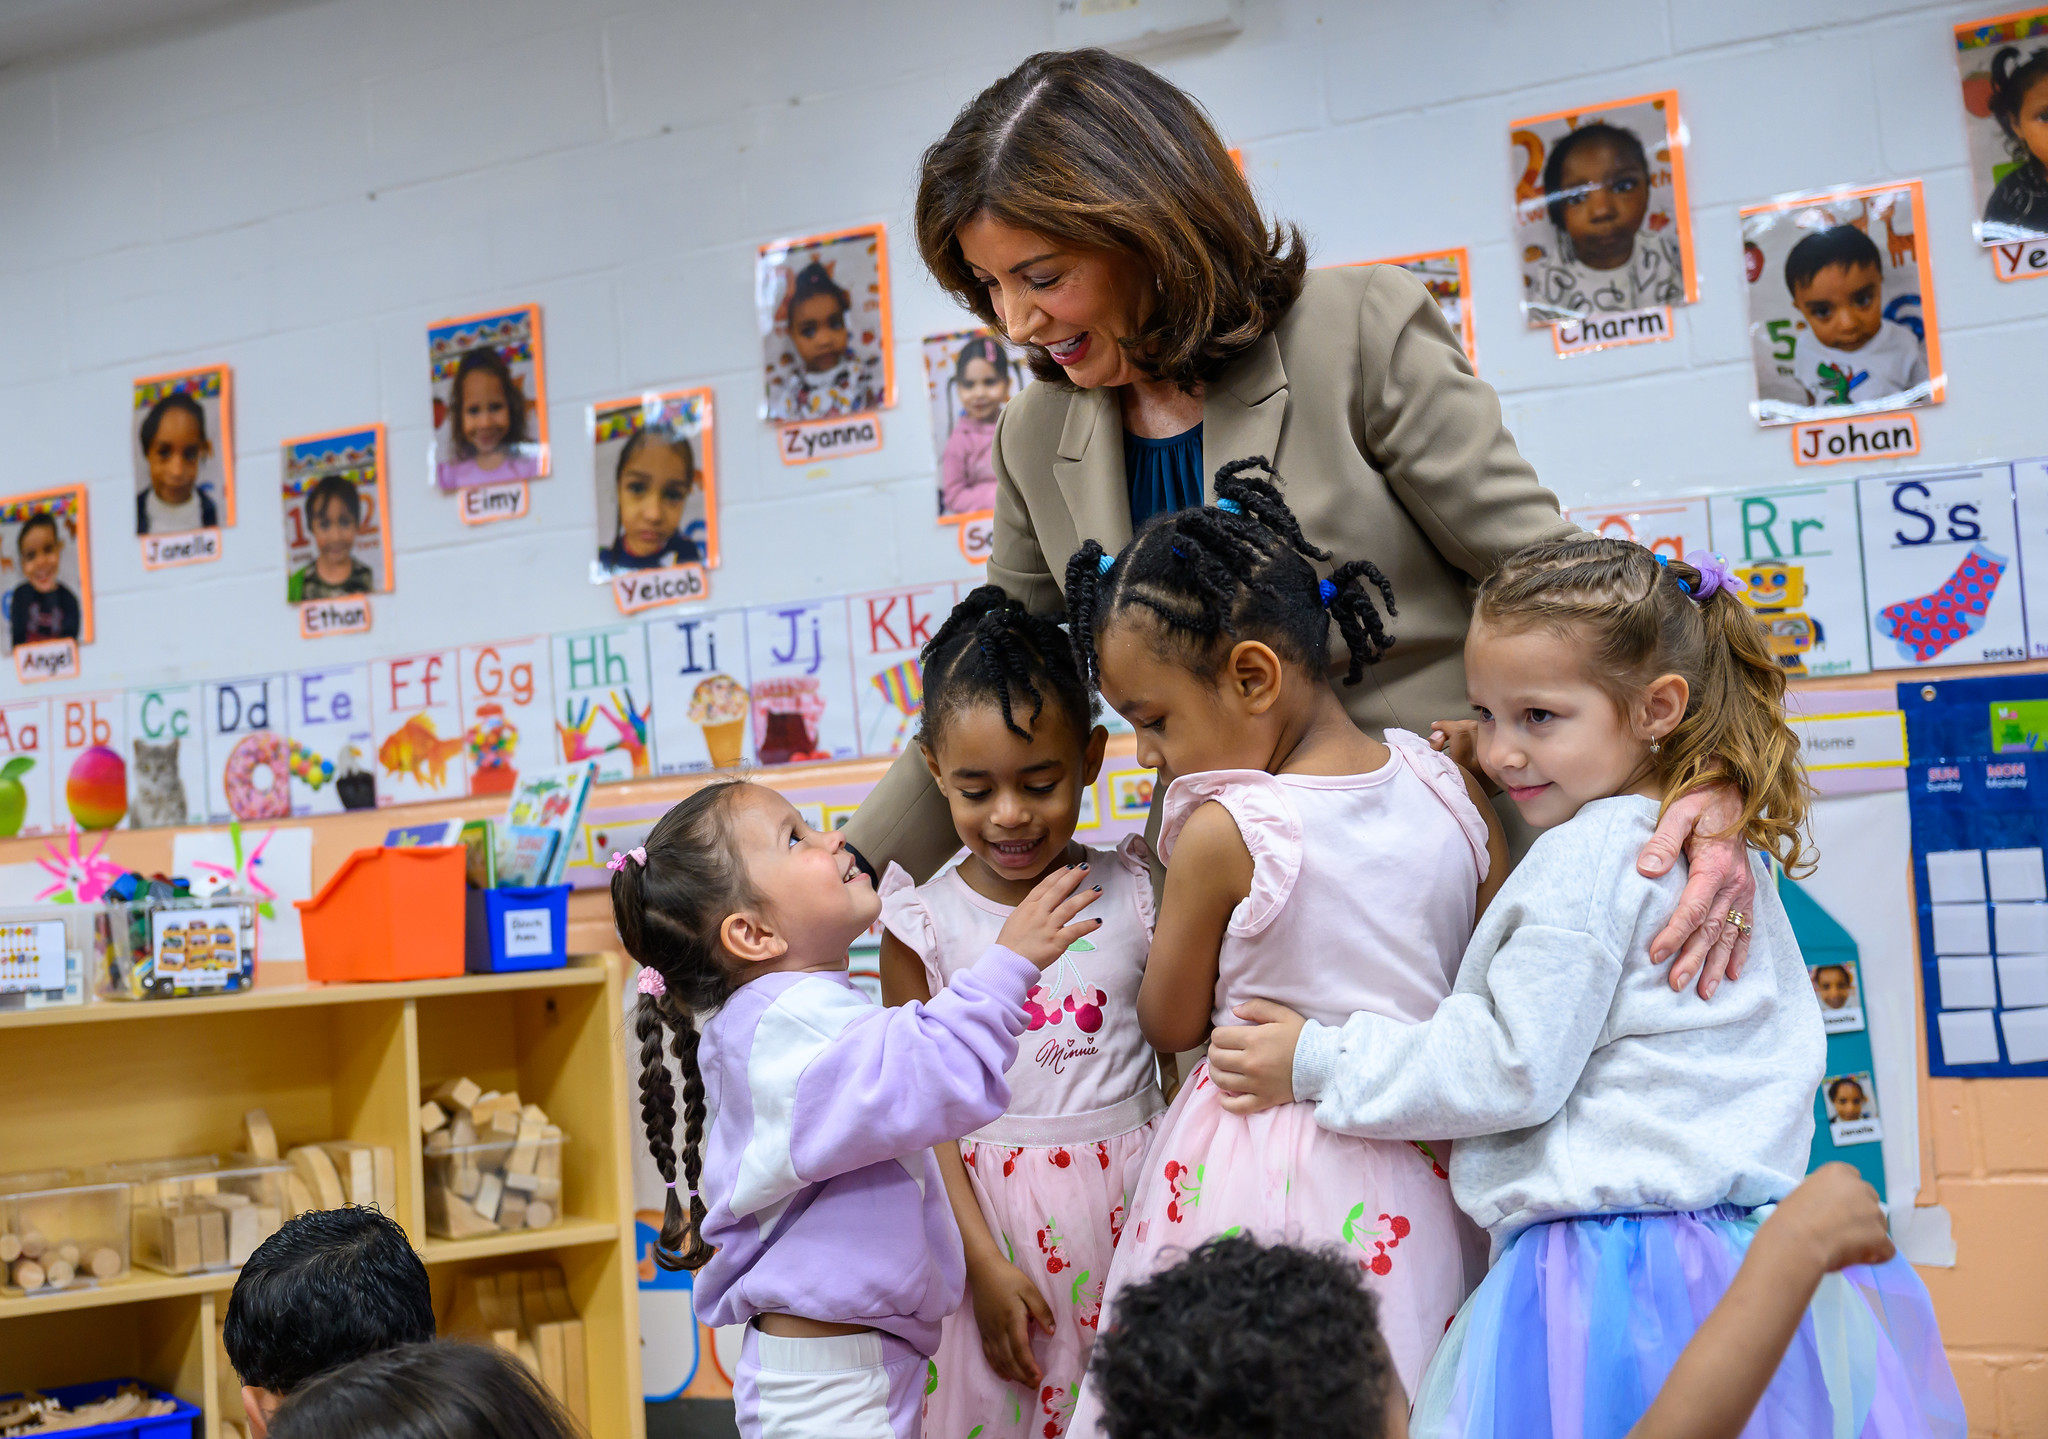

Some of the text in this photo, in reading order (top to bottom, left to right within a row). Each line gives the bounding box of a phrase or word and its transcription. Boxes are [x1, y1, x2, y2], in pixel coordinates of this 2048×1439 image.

[1560, 311, 1664, 345] Charm
[1766, 320, 1797, 361] 5
[784, 422, 875, 458] Zyanna
[1802, 423, 1912, 459] Johan
[465, 488, 522, 516] Eimy
[1891, 480, 1982, 546] Ss
[1741, 498, 1825, 560] Rr
[146, 539, 217, 562] Janelle
[619, 570, 702, 604] Yeicob
[305, 600, 367, 631] Ethan
[867, 594, 932, 654] Kk
[677, 621, 716, 675] Ii
[771, 608, 822, 675] Jj
[1982, 646, 2023, 660] socks
[23, 645, 73, 677] Angel
[475, 648, 534, 706] Gg
[568, 634, 628, 689] Hh
[1811, 659, 1851, 672] robot
[301, 675, 353, 725] Ee
[390, 656, 443, 711] Ff
[65, 700, 112, 748] Bb
[141, 692, 190, 738] Cc
[218, 681, 269, 733] Dd
[1807, 737, 1855, 751] Home
[1926, 781, 1963, 793] Sunday
[1927, 766, 1961, 782] SUN
[1985, 777, 2028, 790] Monday
[1986, 762, 2026, 778] MON
[1035, 1037, 1099, 1075] Minnie
